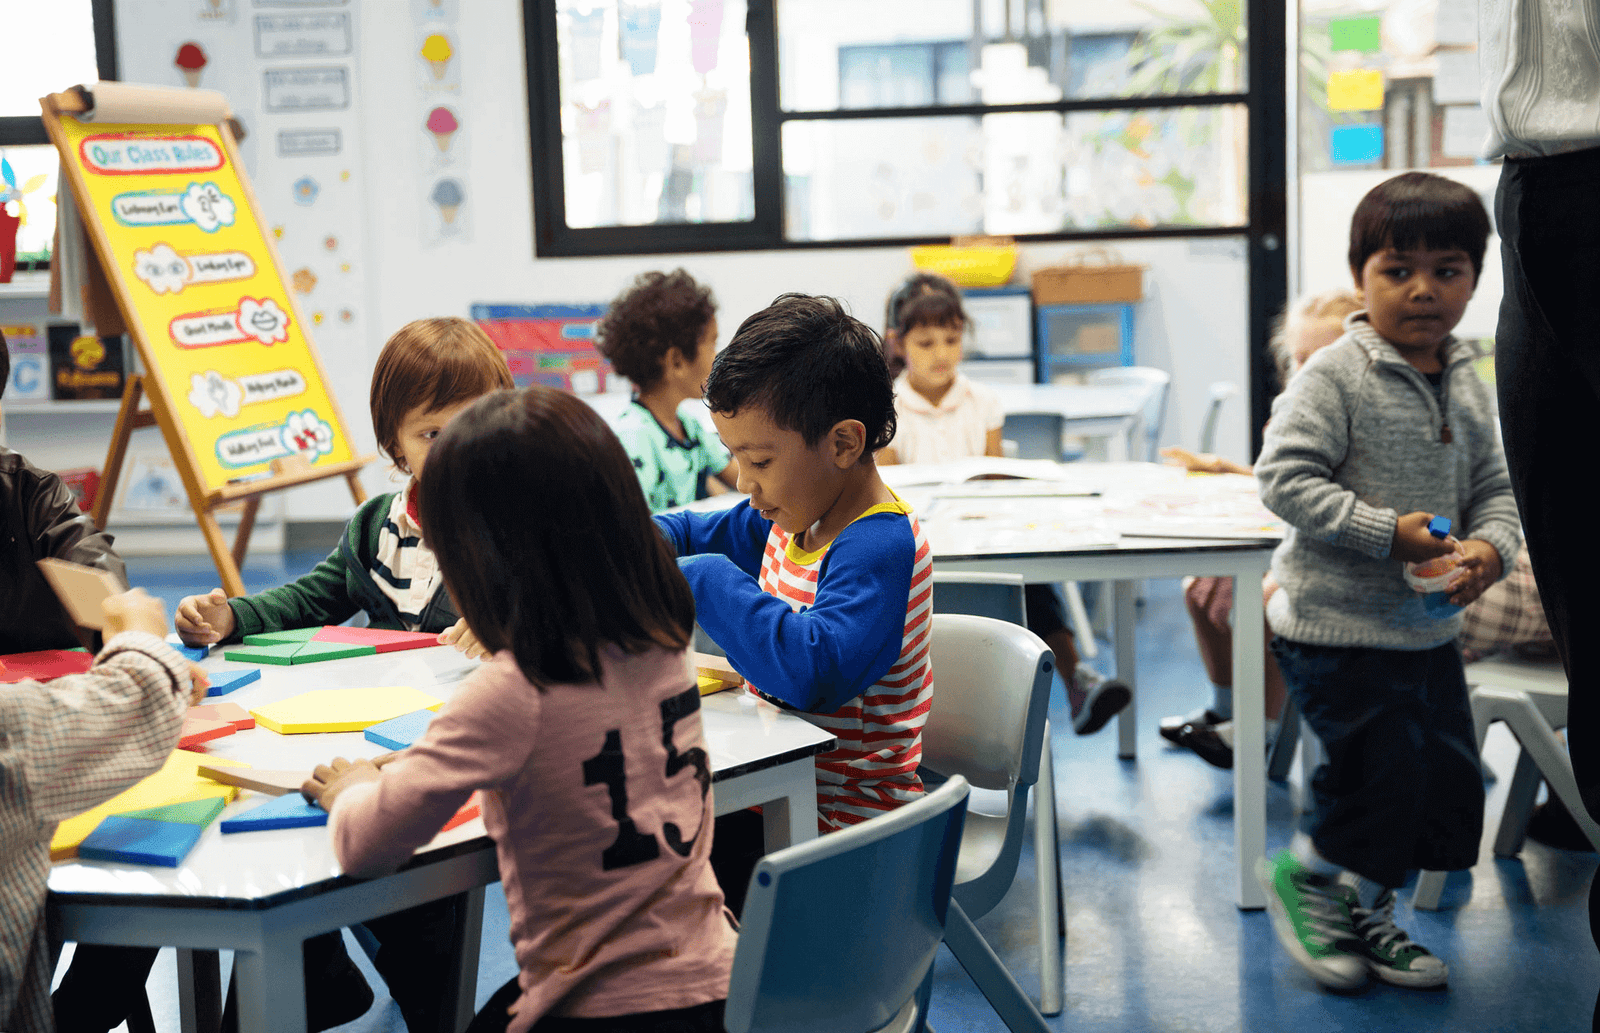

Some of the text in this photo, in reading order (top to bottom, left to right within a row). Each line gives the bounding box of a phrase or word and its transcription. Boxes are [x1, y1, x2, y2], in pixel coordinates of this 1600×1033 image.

[92, 144, 213, 165] Our Class Rules
[583, 683, 711, 871] 15
